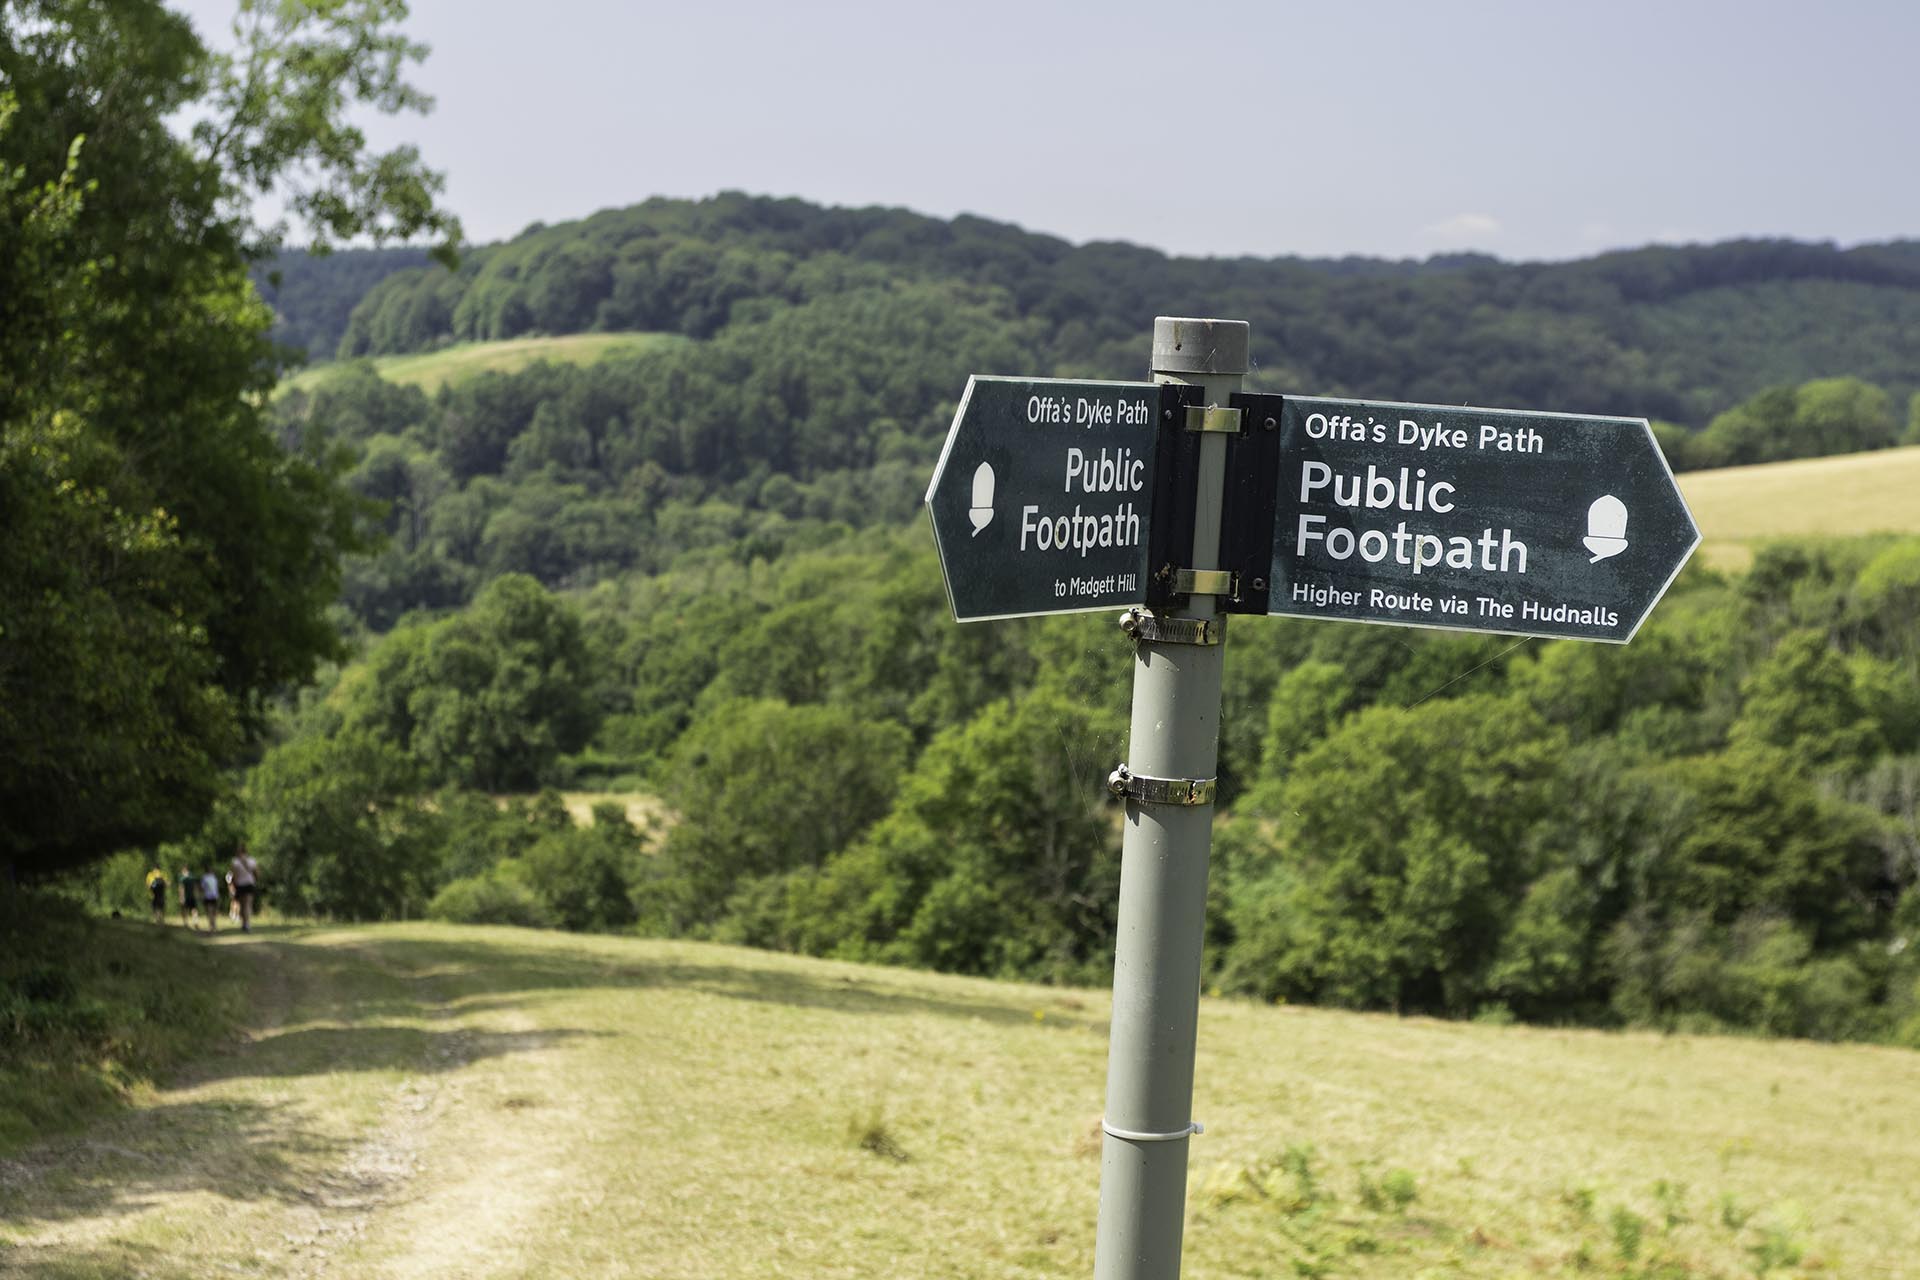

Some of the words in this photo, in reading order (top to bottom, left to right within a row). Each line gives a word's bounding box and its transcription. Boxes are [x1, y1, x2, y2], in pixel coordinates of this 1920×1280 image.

[1027, 395, 1072, 424] Offa's
[1075, 397, 1113, 429] Dyke
[1116, 399, 1149, 425] Path
[1305, 413, 1387, 443] Offa's
[1397, 419, 1468, 452] Dyke
[1478, 424, 1544, 454] Path
[1064, 447, 1145, 493] Public
[1299, 460, 1456, 514] Public
[1020, 502, 1140, 558] Footpath
[1296, 513, 1528, 575] Footpath
[1054, 578, 1067, 597] to
[1069, 575, 1115, 598] Madgett
[1117, 573, 1136, 593] Hill
[1292, 582, 1362, 607] Higher
[1369, 588, 1433, 612] Route
[1439, 594, 1469, 615] via
[1475, 596, 1514, 619] The
[1521, 600, 1619, 627] Hudnalls
